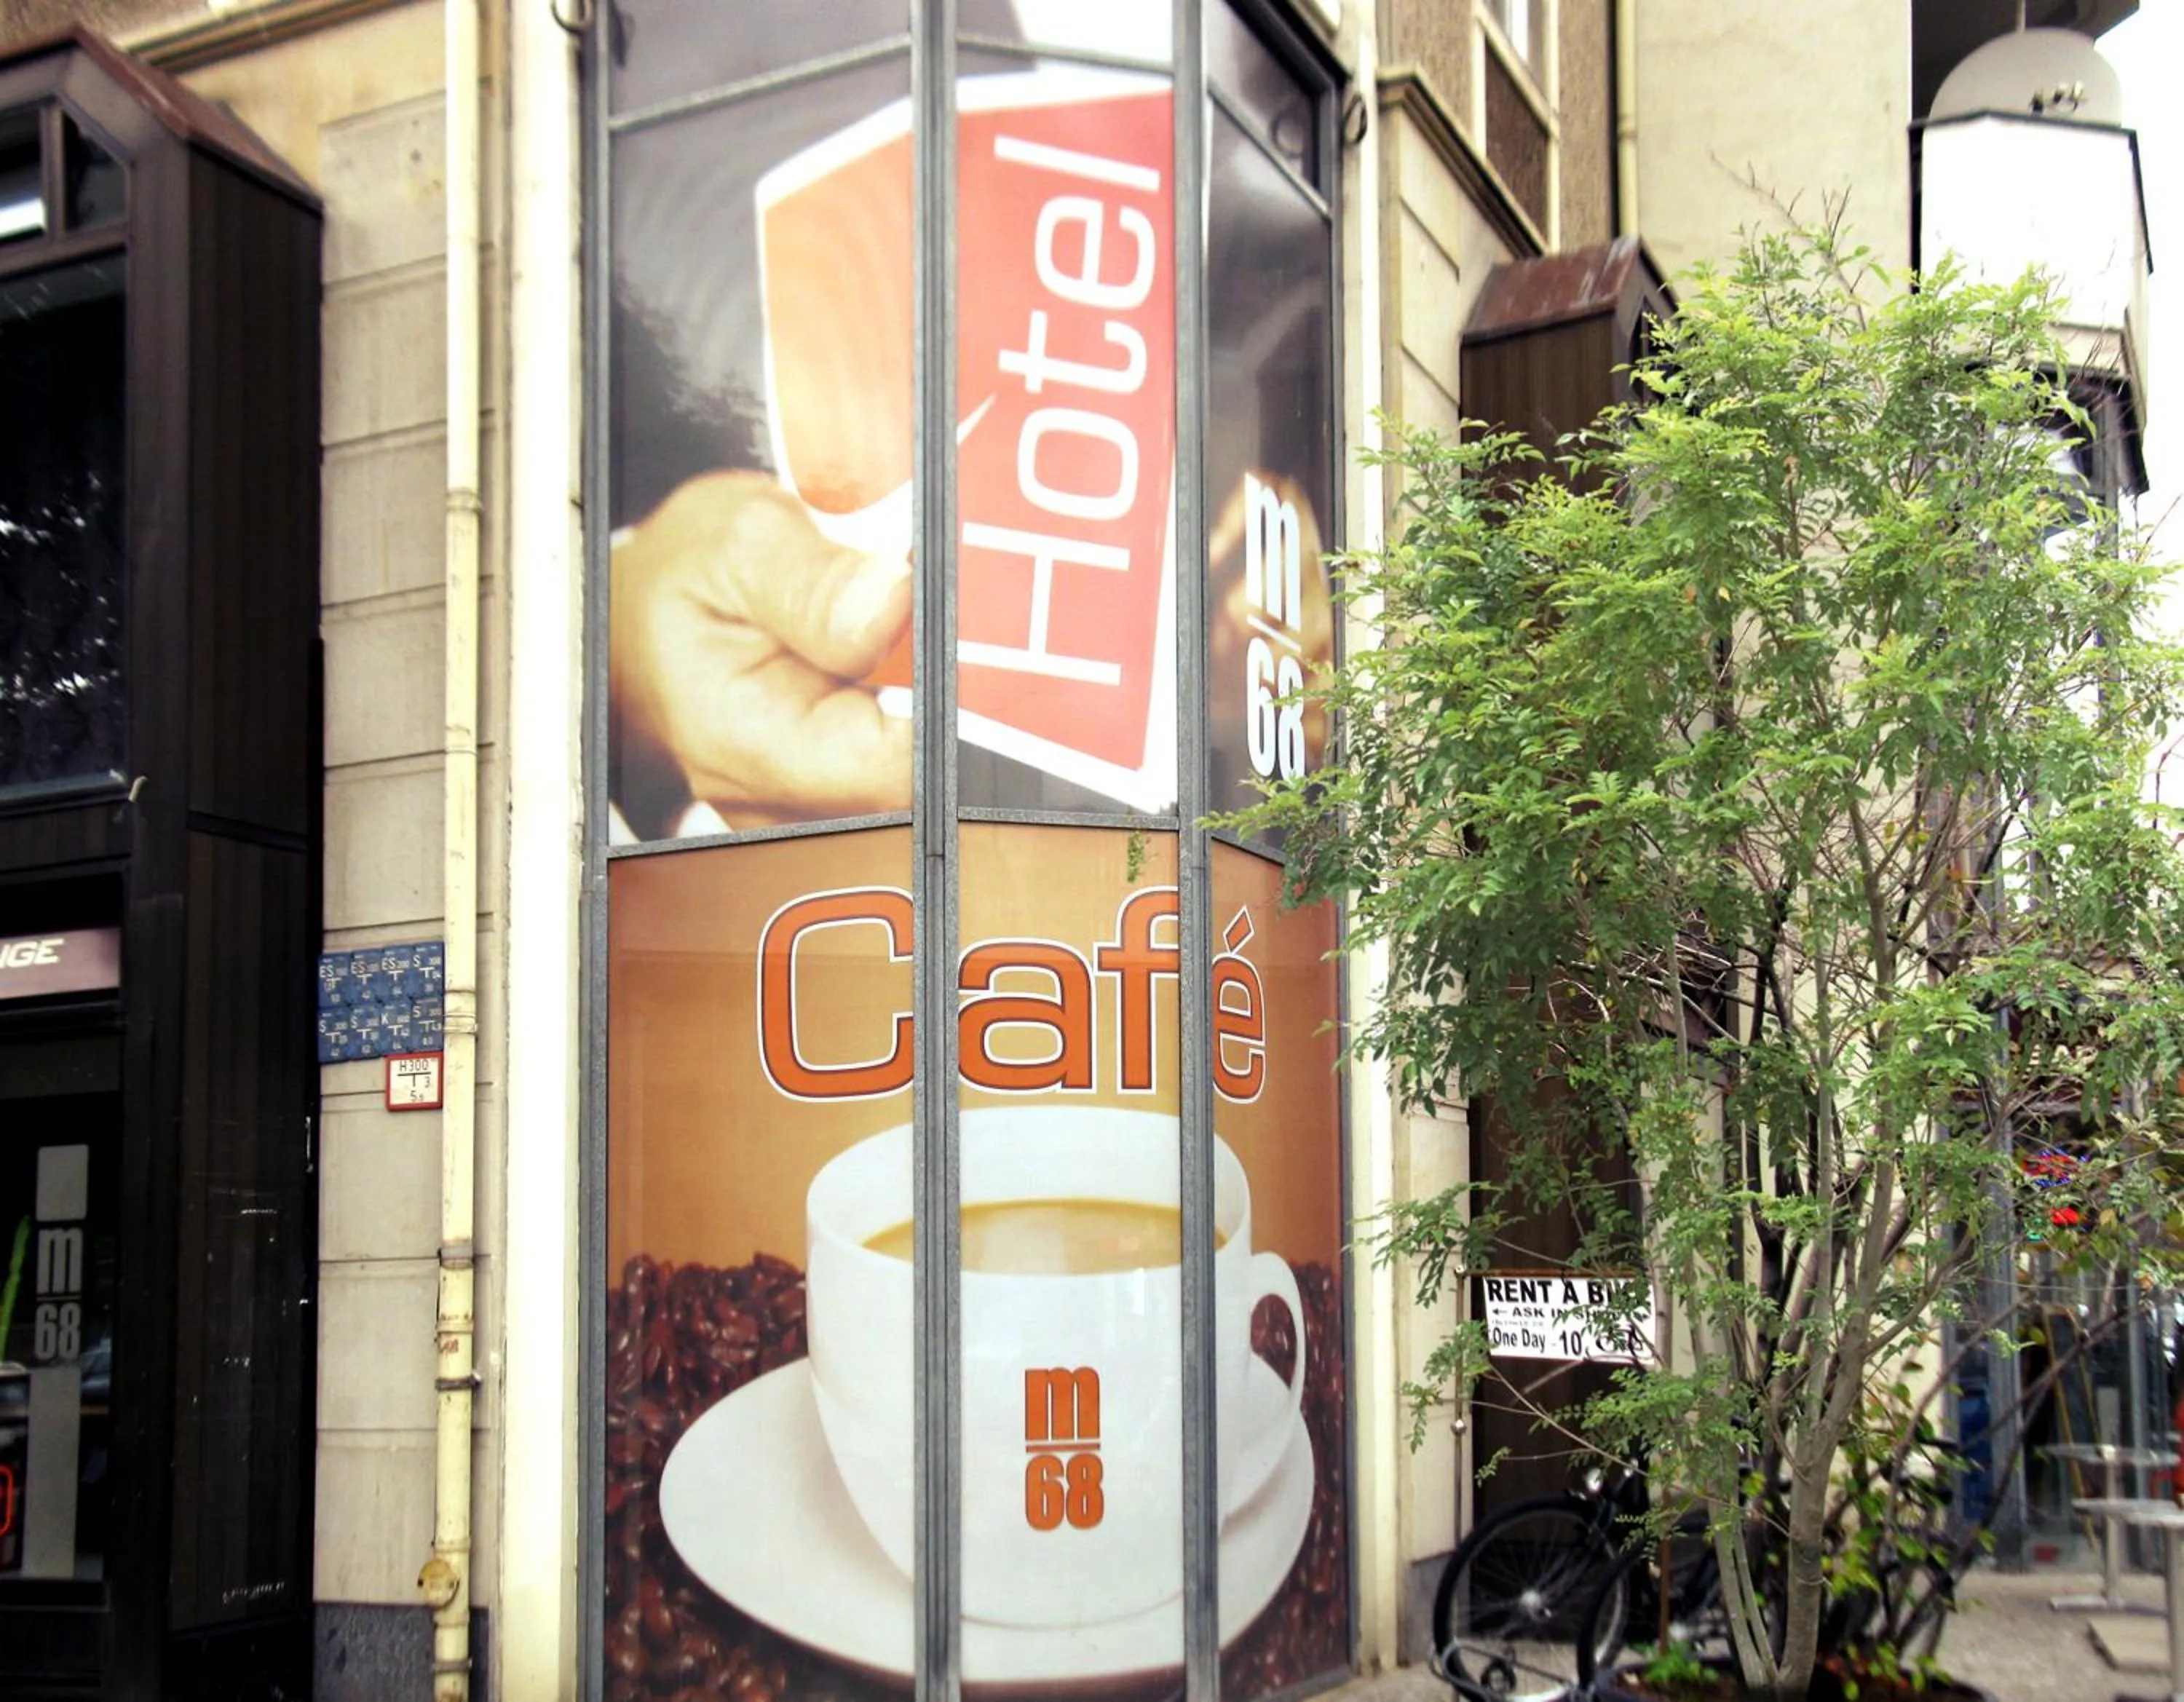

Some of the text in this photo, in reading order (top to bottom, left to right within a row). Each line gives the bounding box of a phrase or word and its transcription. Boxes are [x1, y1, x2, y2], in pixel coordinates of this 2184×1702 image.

[957, 134, 1160, 686] Hotel
[1245, 472, 1301, 633] m
[1247, 636, 1306, 785] 68
[757, 884, 1265, 1103] Café
[36, 1228, 83, 1294] m
[1486, 1280, 1553, 1304] RENT
[1563, 1281, 1579, 1305] A
[36, 1302, 82, 1361] 68
[1493, 1326, 1582, 1355] One Day 10
[1513, 1307, 1545, 1318] ASK
[1025, 1366, 1101, 1441] m
[1025, 1453, 1104, 1532] 68
